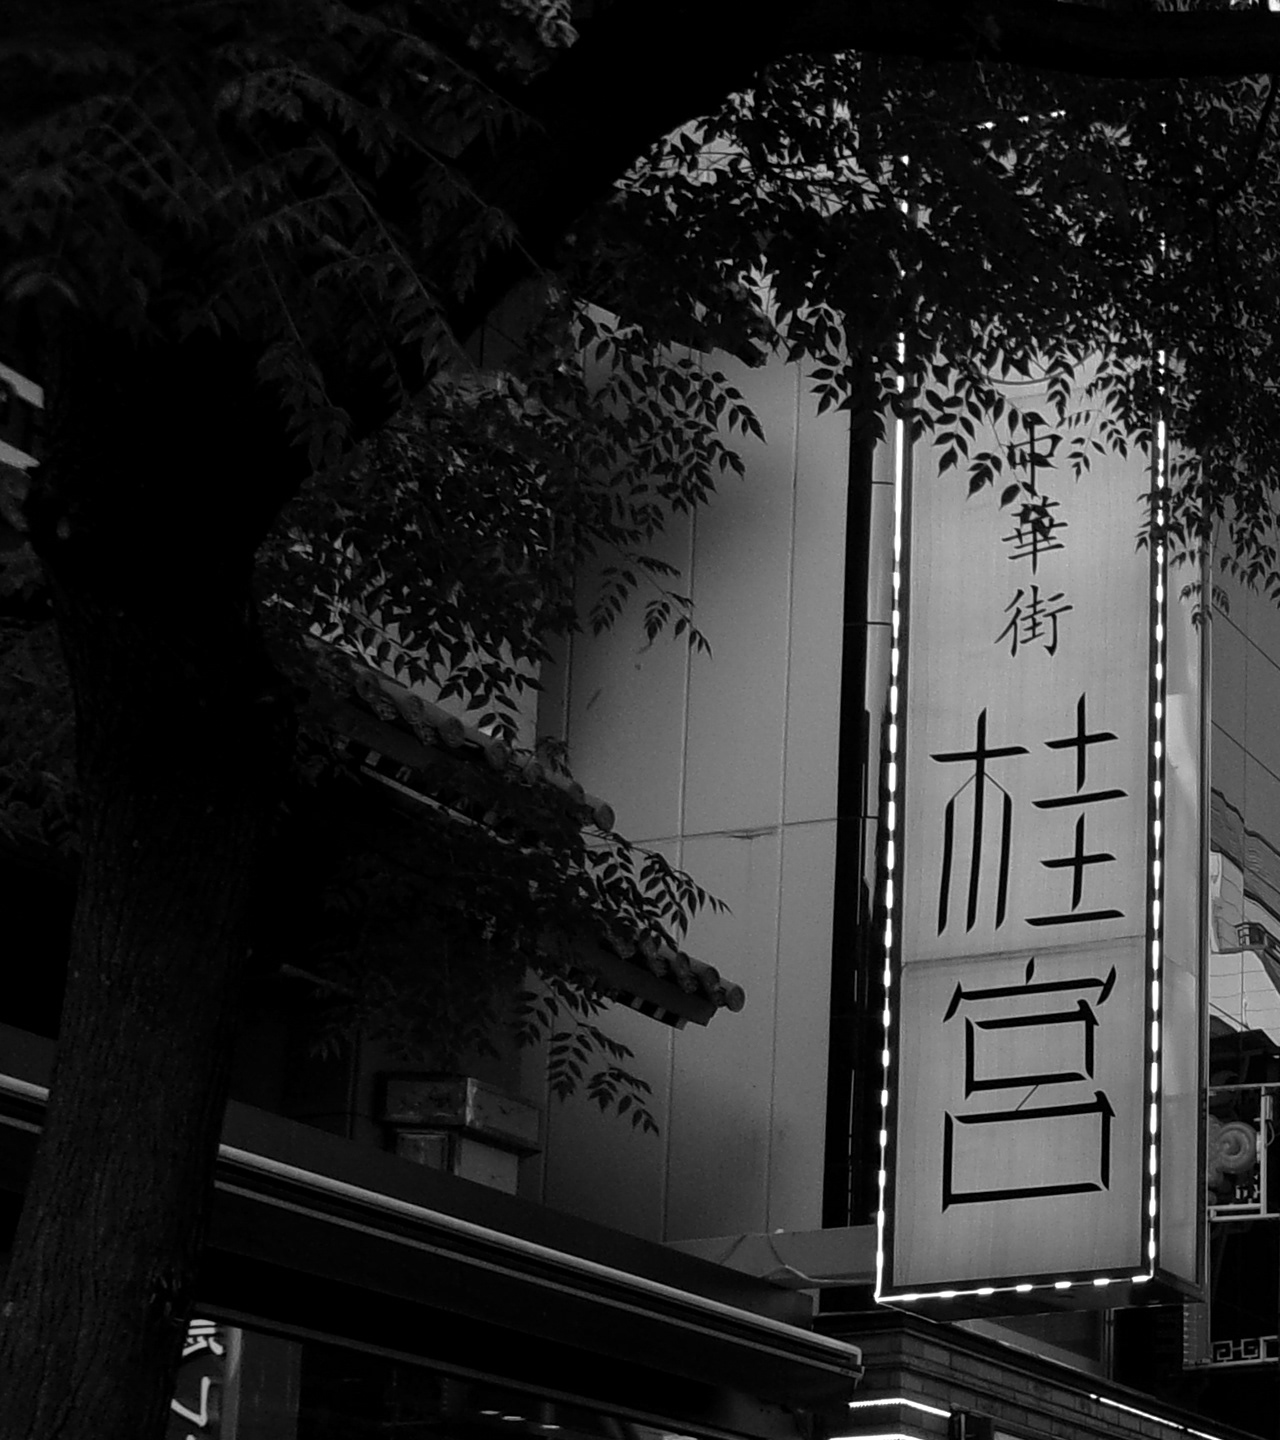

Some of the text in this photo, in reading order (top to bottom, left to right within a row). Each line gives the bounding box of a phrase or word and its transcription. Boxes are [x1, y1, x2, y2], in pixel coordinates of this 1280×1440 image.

[994, 416, 1073, 658] 中華街
[930, 692, 1128, 1214] 桂宮
